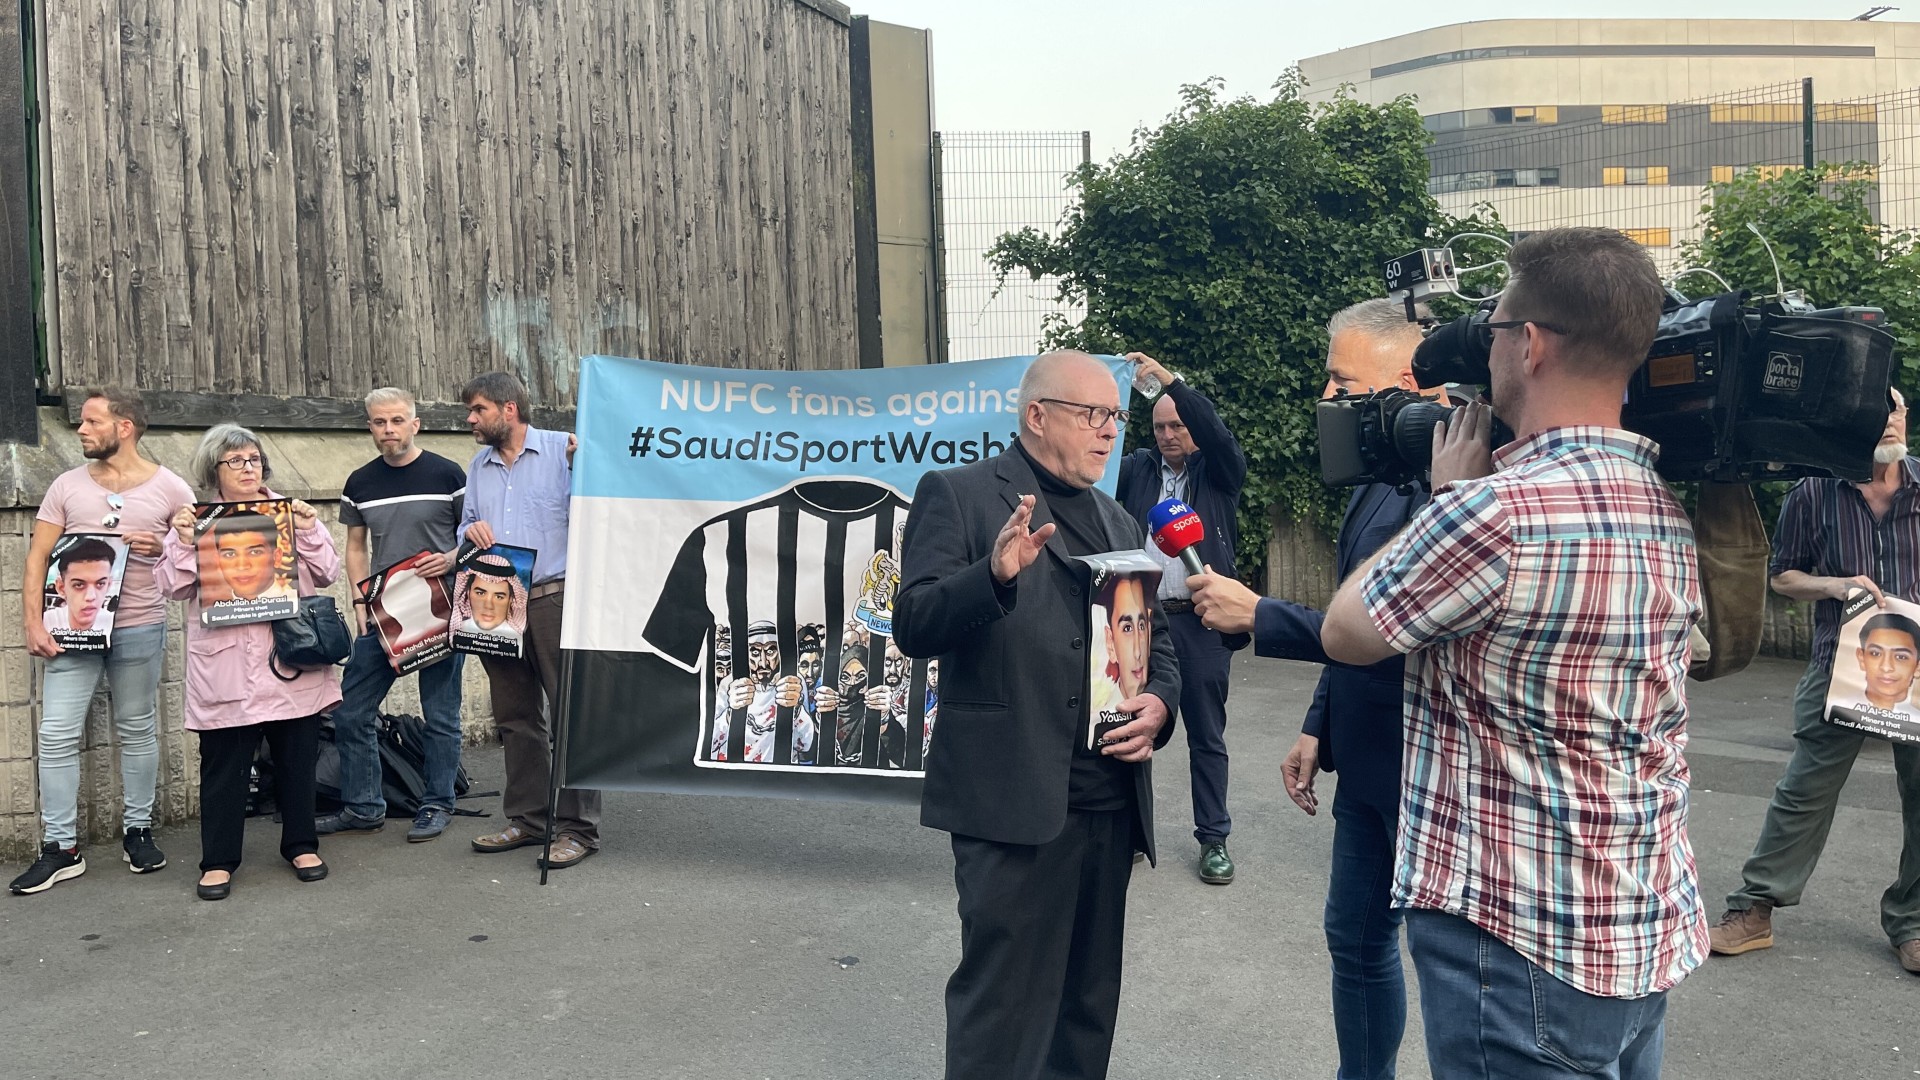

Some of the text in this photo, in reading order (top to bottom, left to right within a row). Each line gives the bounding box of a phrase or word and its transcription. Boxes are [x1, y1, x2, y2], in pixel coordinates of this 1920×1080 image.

[1386, 261, 1401, 279] 60
[1769, 361, 1799, 377] porta
[1766, 374, 1798, 388] brace
[660, 379, 1019, 426] NUFC fans agains
[202, 505, 224, 526] DANGER
[1169, 504, 1187, 515] sky
[1173, 516, 1200, 531] sports
[214, 596, 287, 608] Abdullah al-Durazi
[1852, 594, 1873, 611] DANGE
[871, 619, 892, 630] NEWC
[455, 631, 477, 639] Hassan
[492, 635, 517, 646] al-Faraj
[403, 641, 424, 654] Mahdi
[403, 661, 417, 670] Saudi
[417, 655, 434, 664] Arabia
[1854, 704, 1866, 712] Ali
[1834, 718, 1855, 728] Saudi
[1855, 723, 1880, 733] Arabia
[1887, 731, 1906, 740] going
[1886, 721, 1901, 729] that
